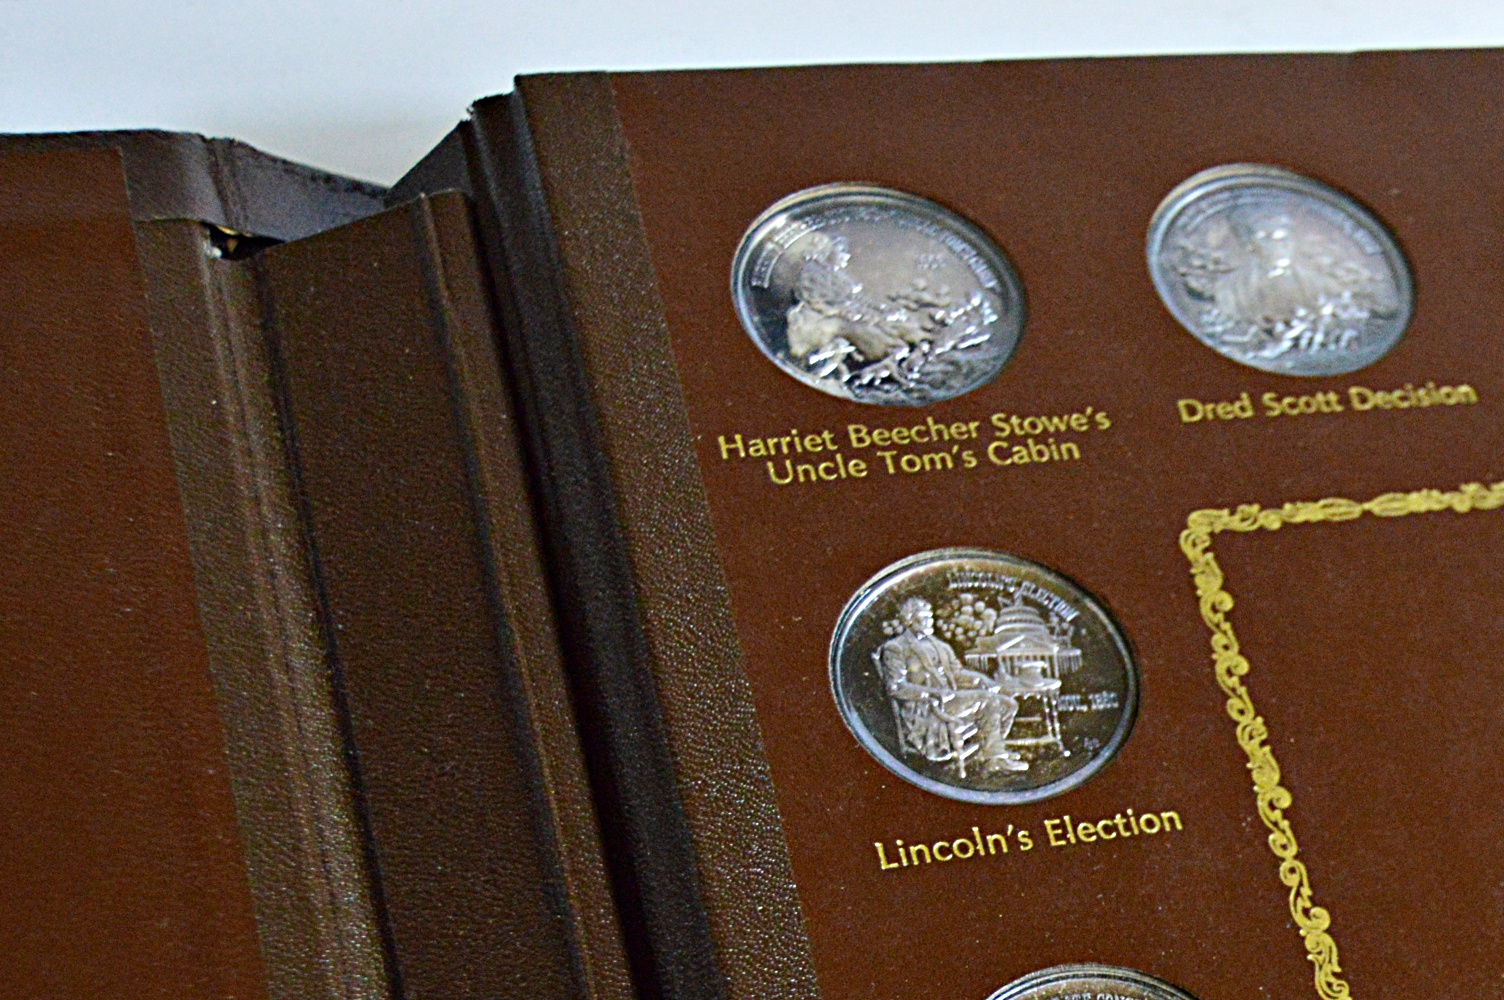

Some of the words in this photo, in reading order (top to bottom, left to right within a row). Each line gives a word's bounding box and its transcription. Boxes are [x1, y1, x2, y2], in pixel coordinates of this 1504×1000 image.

[1177, 391, 1254, 424] Dred
[1261, 390, 1345, 418] Scott
[1348, 381, 1478, 411] Decision
[717, 428, 844, 461] Harriet
[847, 416, 980, 449] Beecher
[991, 406, 1112, 438] Stowe's
[767, 452, 868, 486] Uncle
[876, 444, 978, 475] Tom's
[987, 437, 1082, 466] Cabin
[874, 824, 1034, 870] Lincoln's
[1043, 808, 1183, 847] Election
